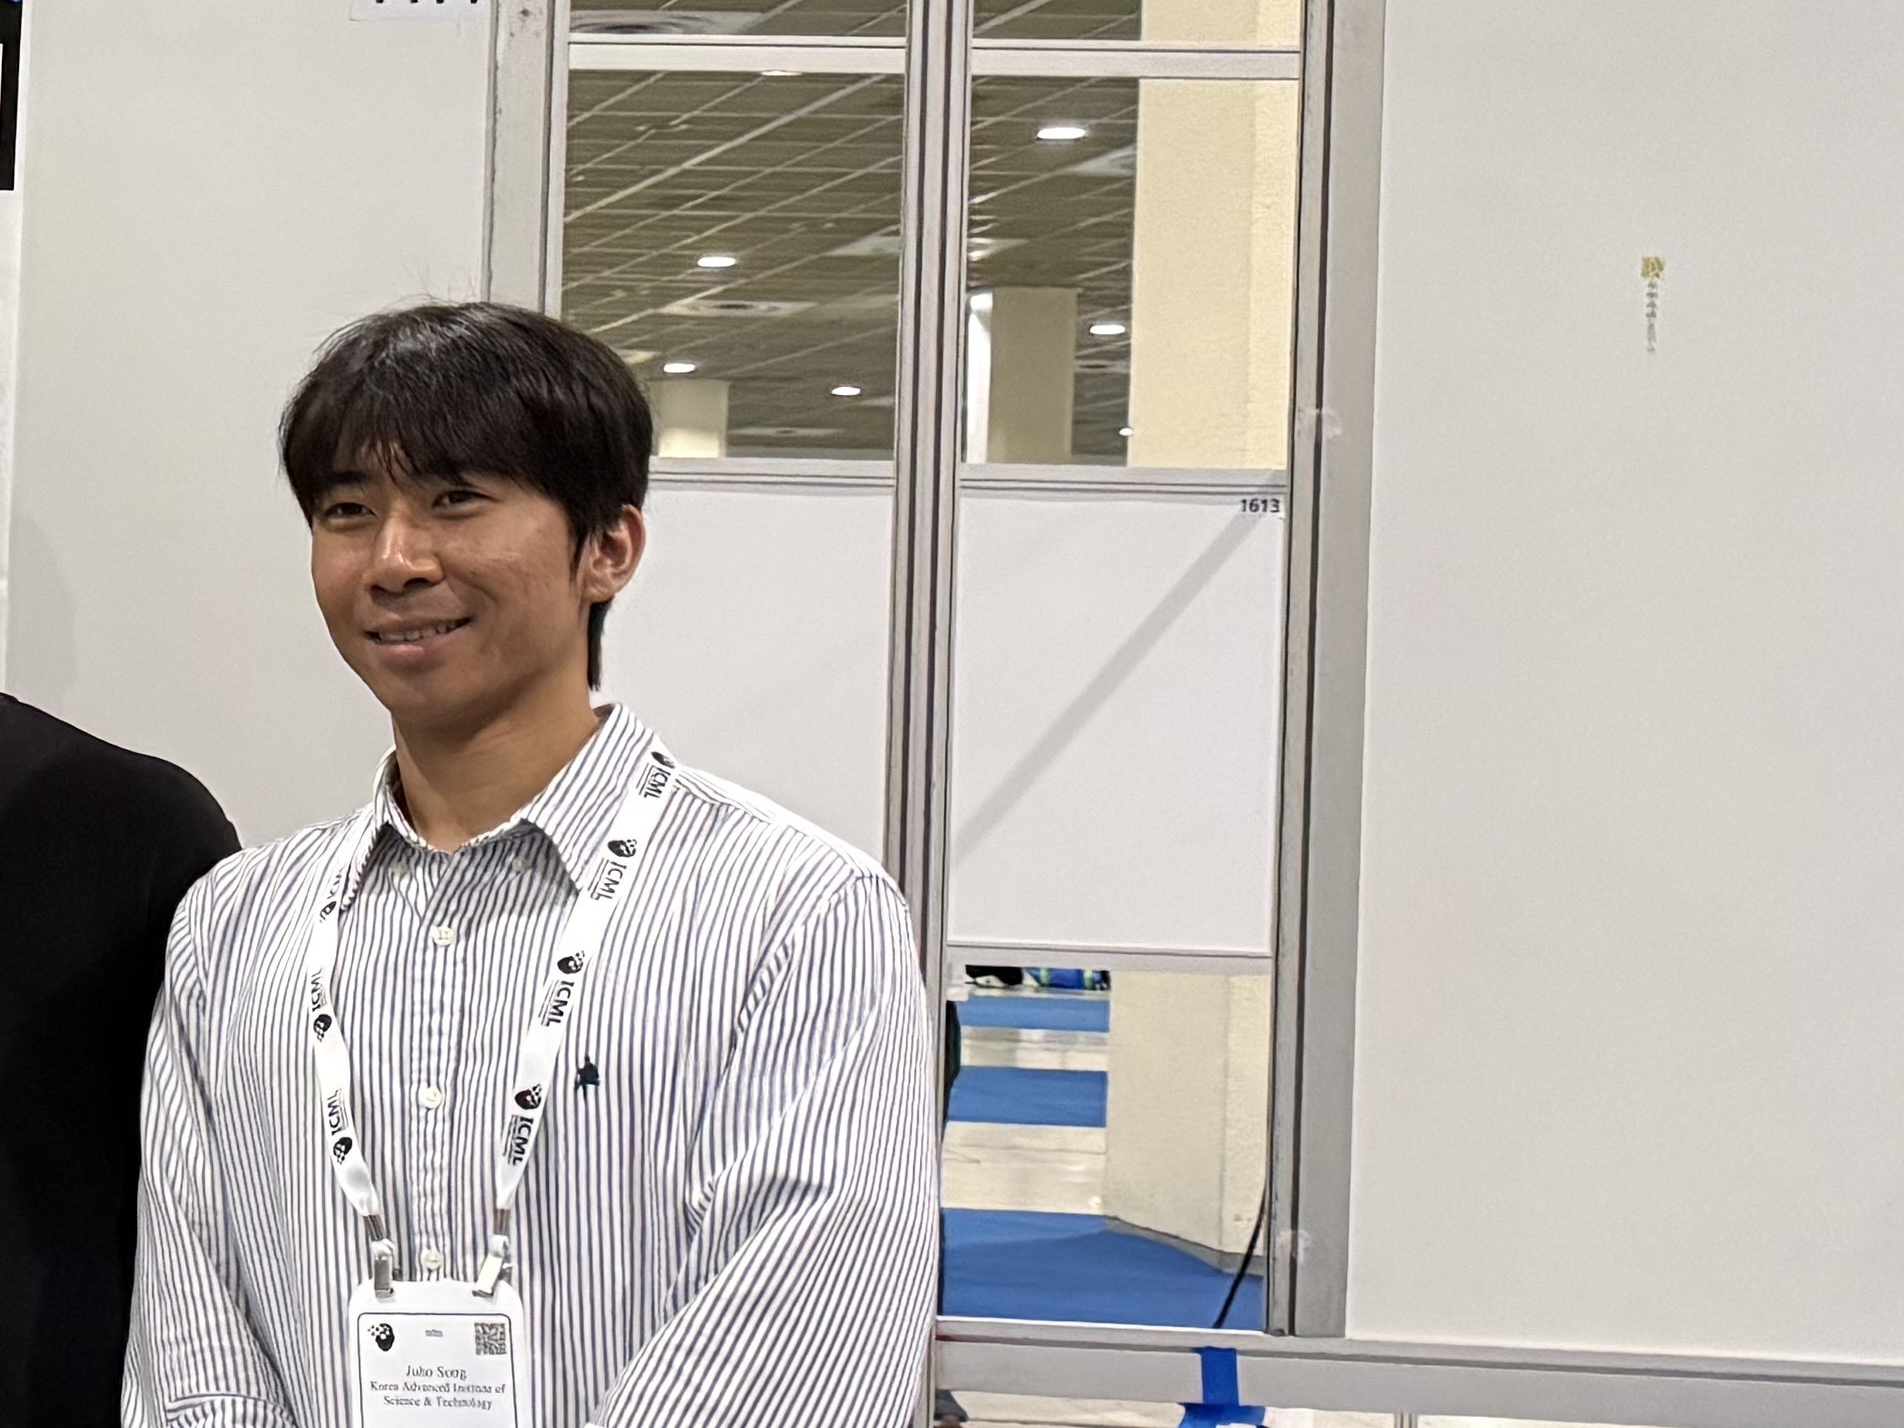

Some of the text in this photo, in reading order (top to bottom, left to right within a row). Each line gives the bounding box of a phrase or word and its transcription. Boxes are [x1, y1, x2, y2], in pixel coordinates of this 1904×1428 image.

[1240, 498, 1281, 513] 1613
[646, 767, 671, 800] ICML
[598, 860, 628, 901] ICML
[544, 980, 575, 1027] ICML
[511, 1116, 534, 1165] ICML
